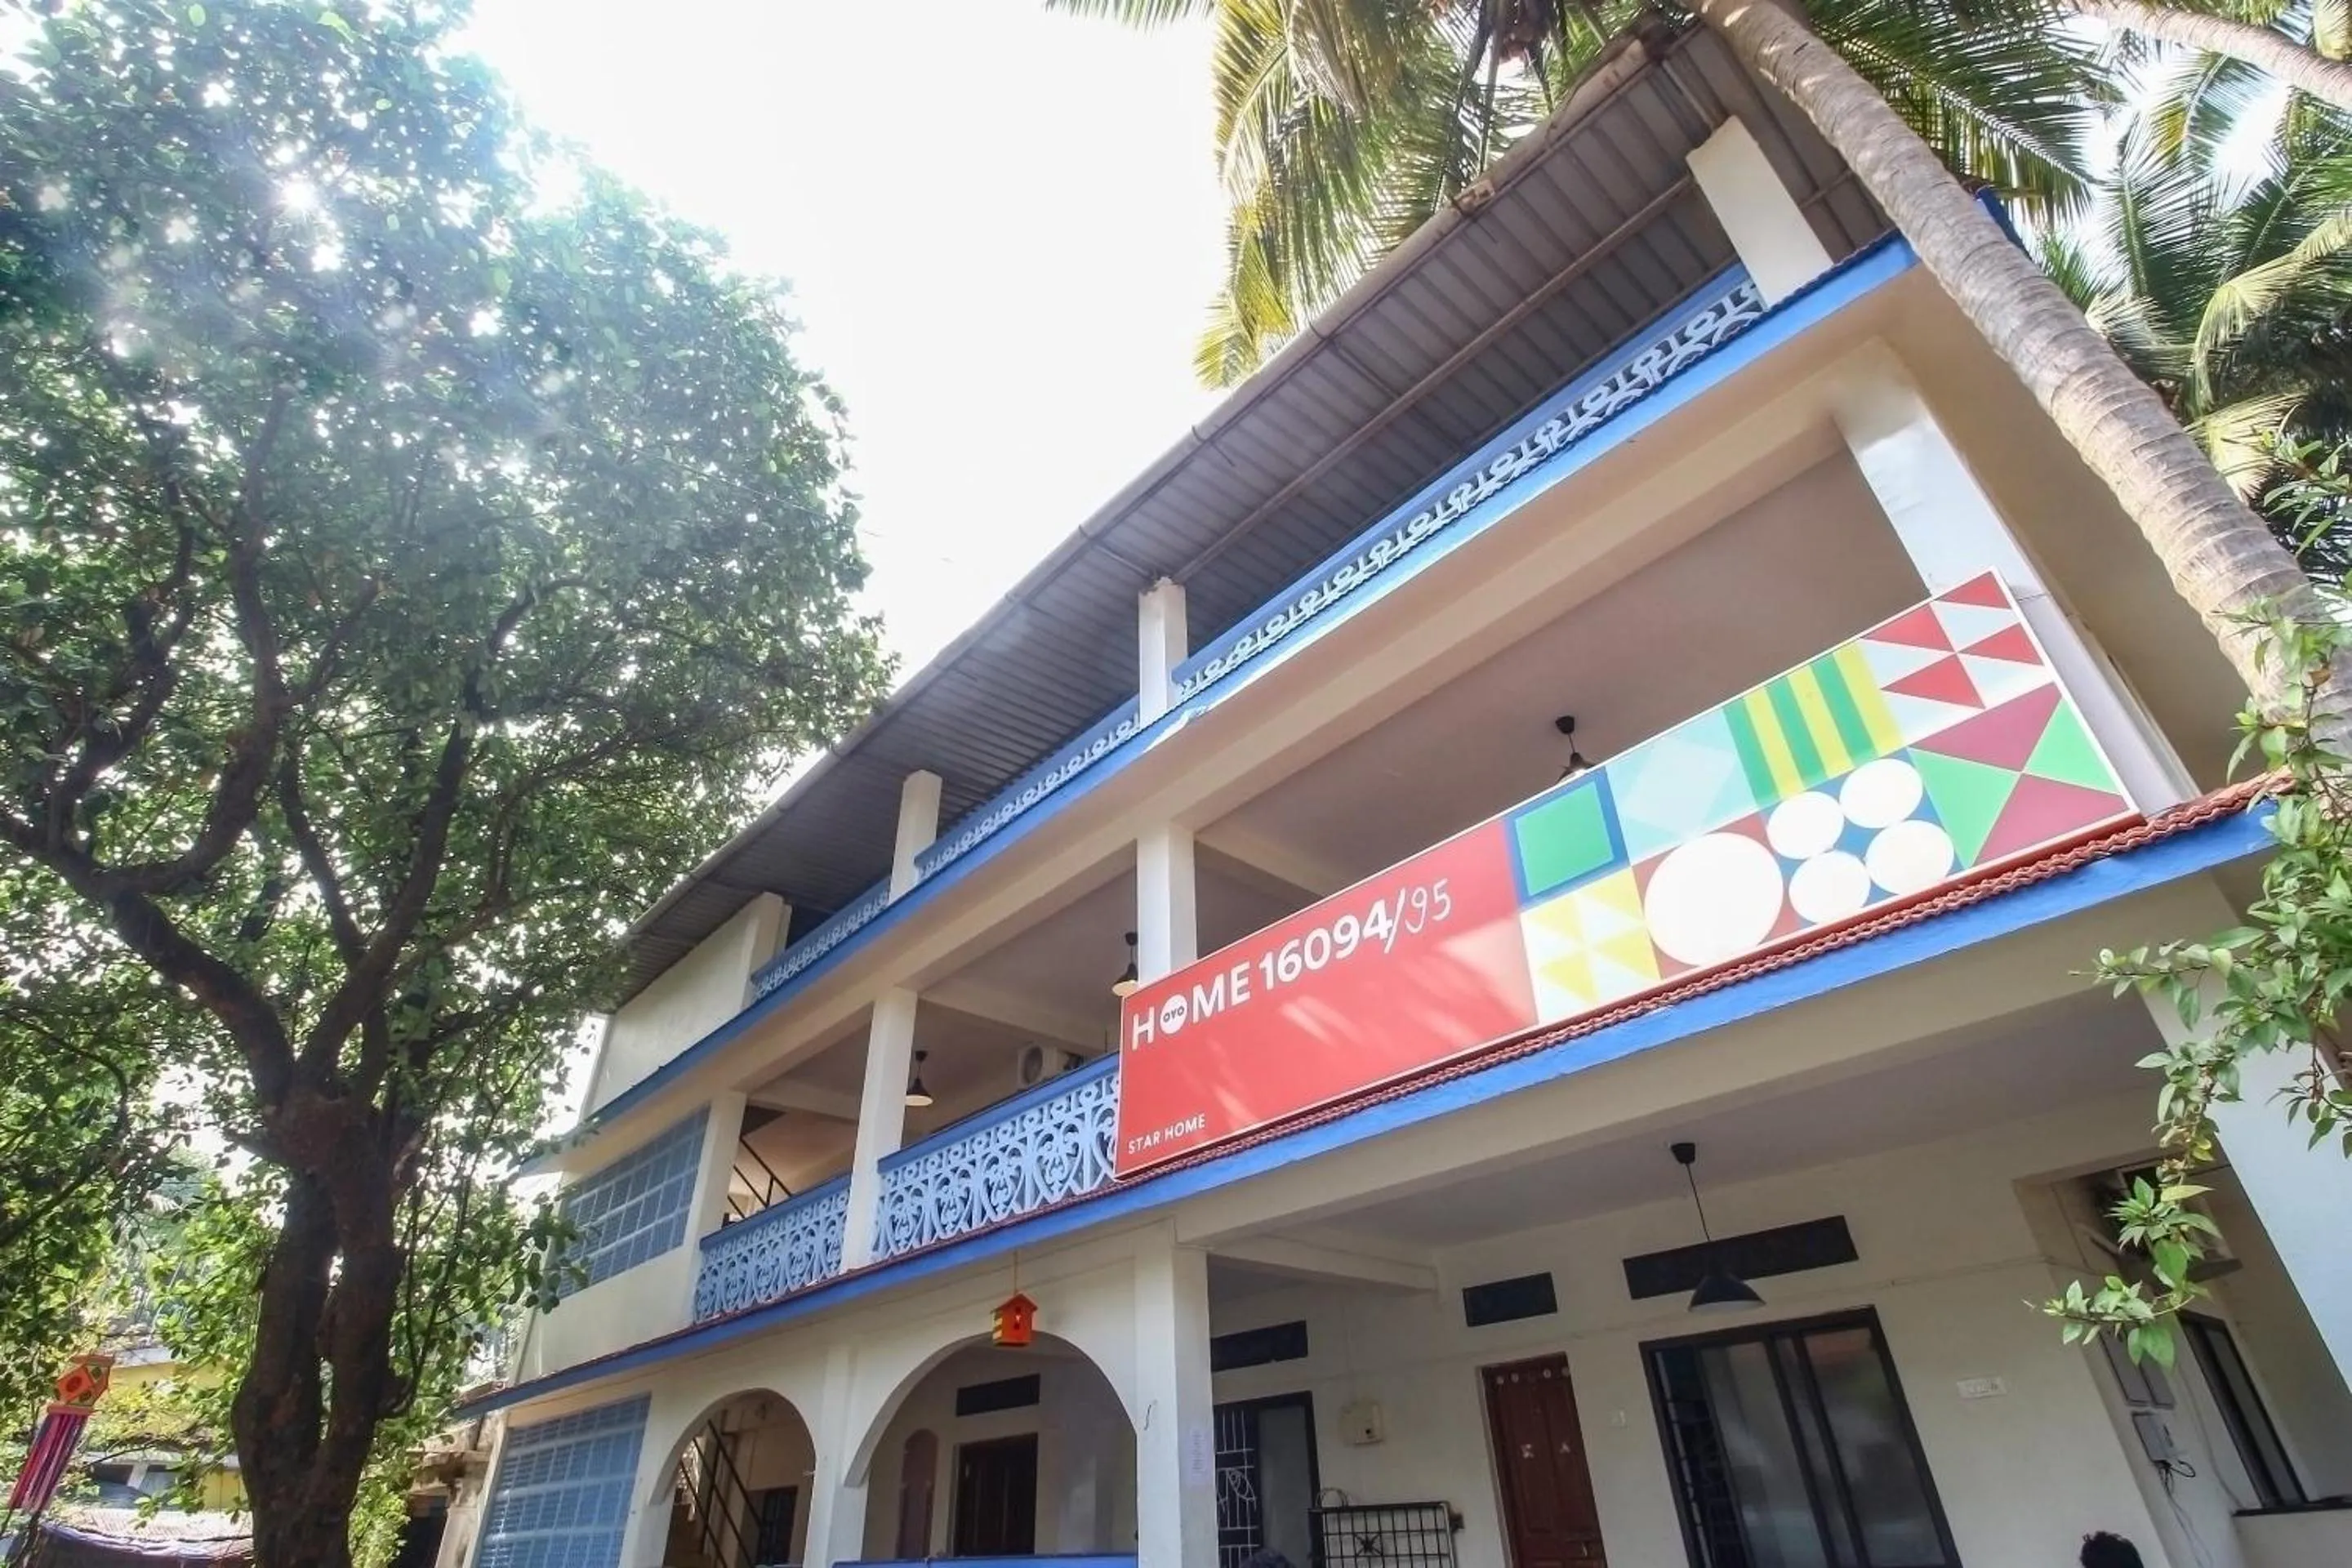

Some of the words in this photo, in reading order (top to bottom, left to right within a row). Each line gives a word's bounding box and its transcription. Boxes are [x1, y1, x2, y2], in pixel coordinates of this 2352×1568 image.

[1132, 960, 1251, 1052] HOME
[1258, 878, 1451, 990] 16094/95
[1163, 1005, 1185, 1023] OYO
[1129, 1131, 1160, 1155] STAR
[1165, 1113, 1205, 1141] HOME
